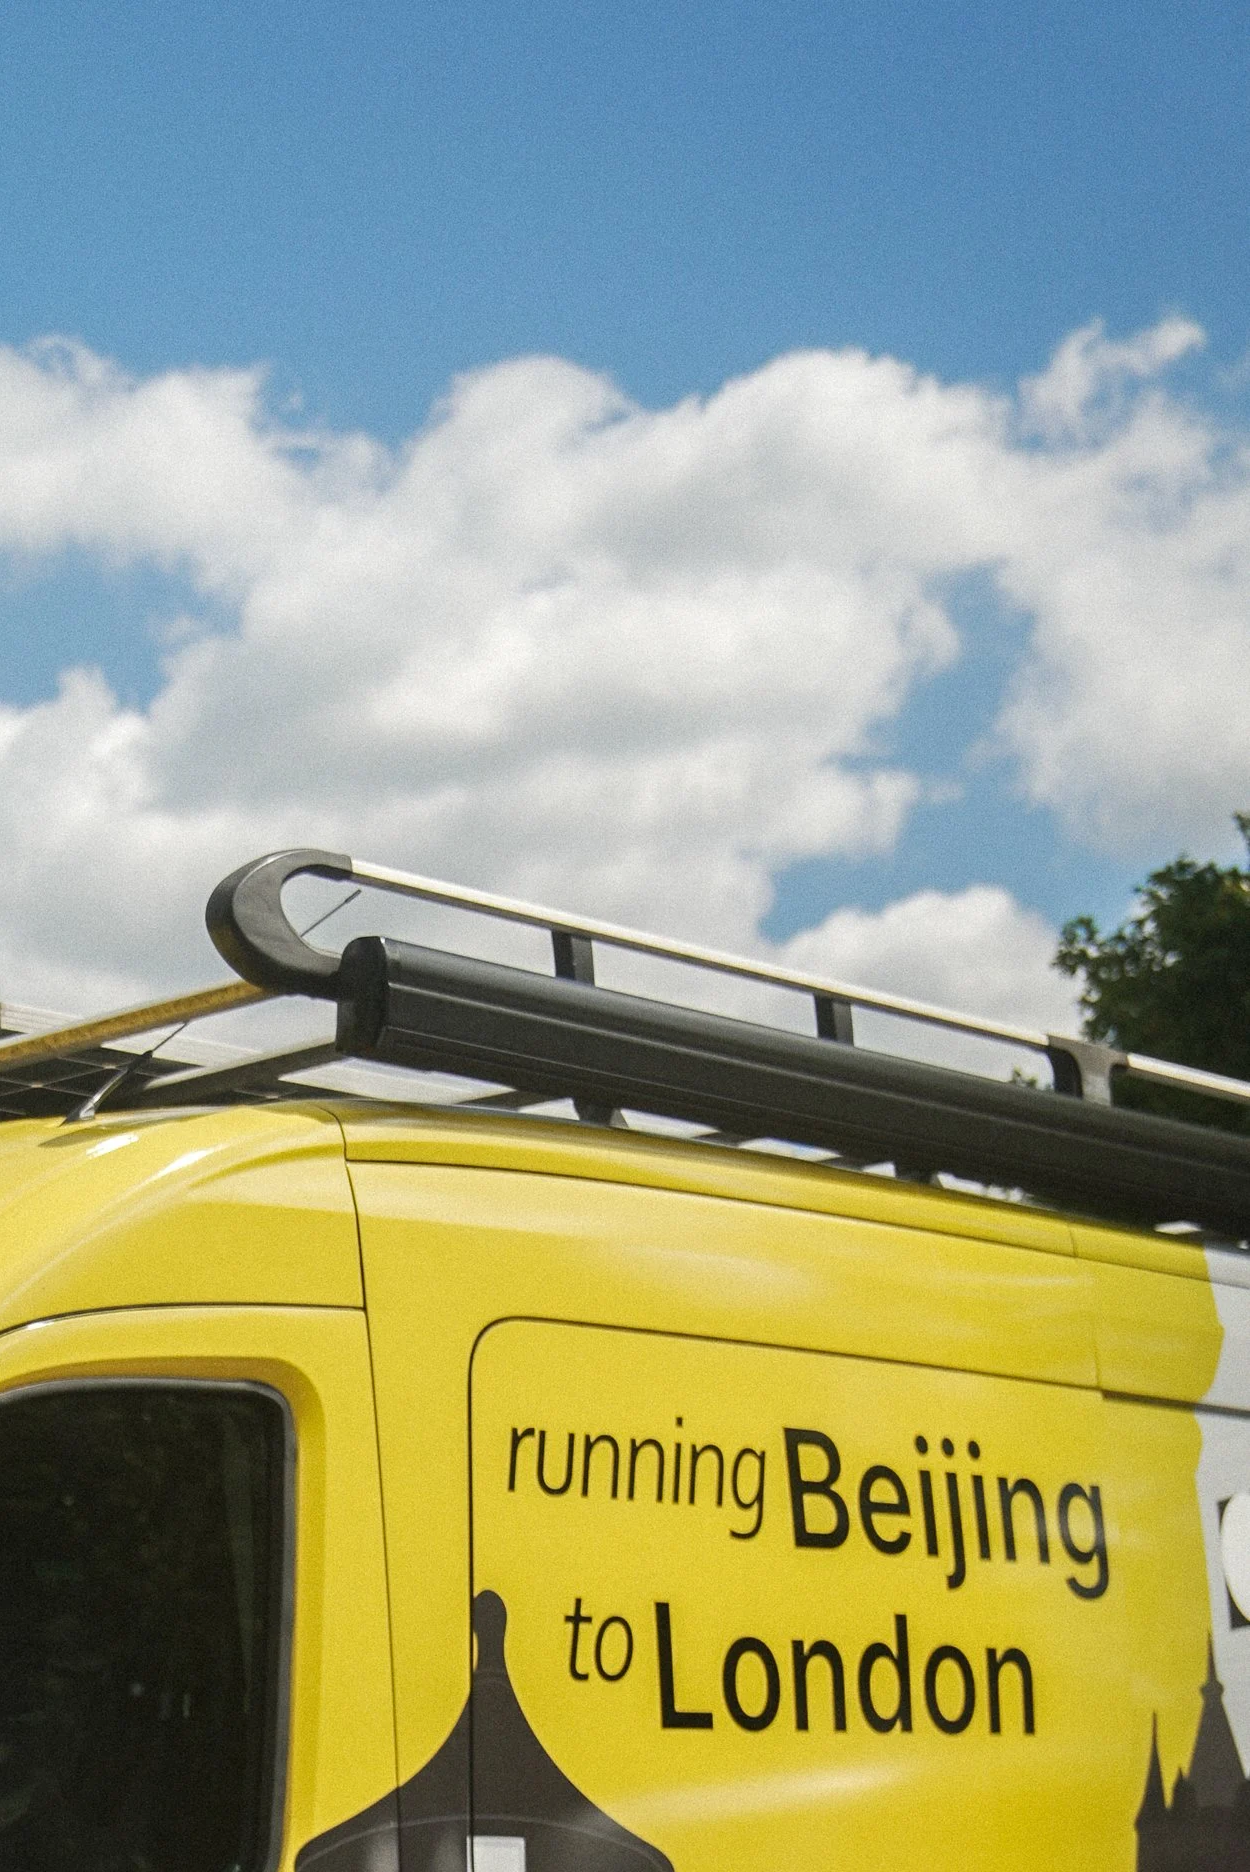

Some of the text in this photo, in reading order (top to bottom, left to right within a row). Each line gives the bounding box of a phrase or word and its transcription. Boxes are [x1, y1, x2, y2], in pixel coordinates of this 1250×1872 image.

[507, 1416, 1111, 1602] running Beijing
[563, 1597, 1037, 1736] to London
